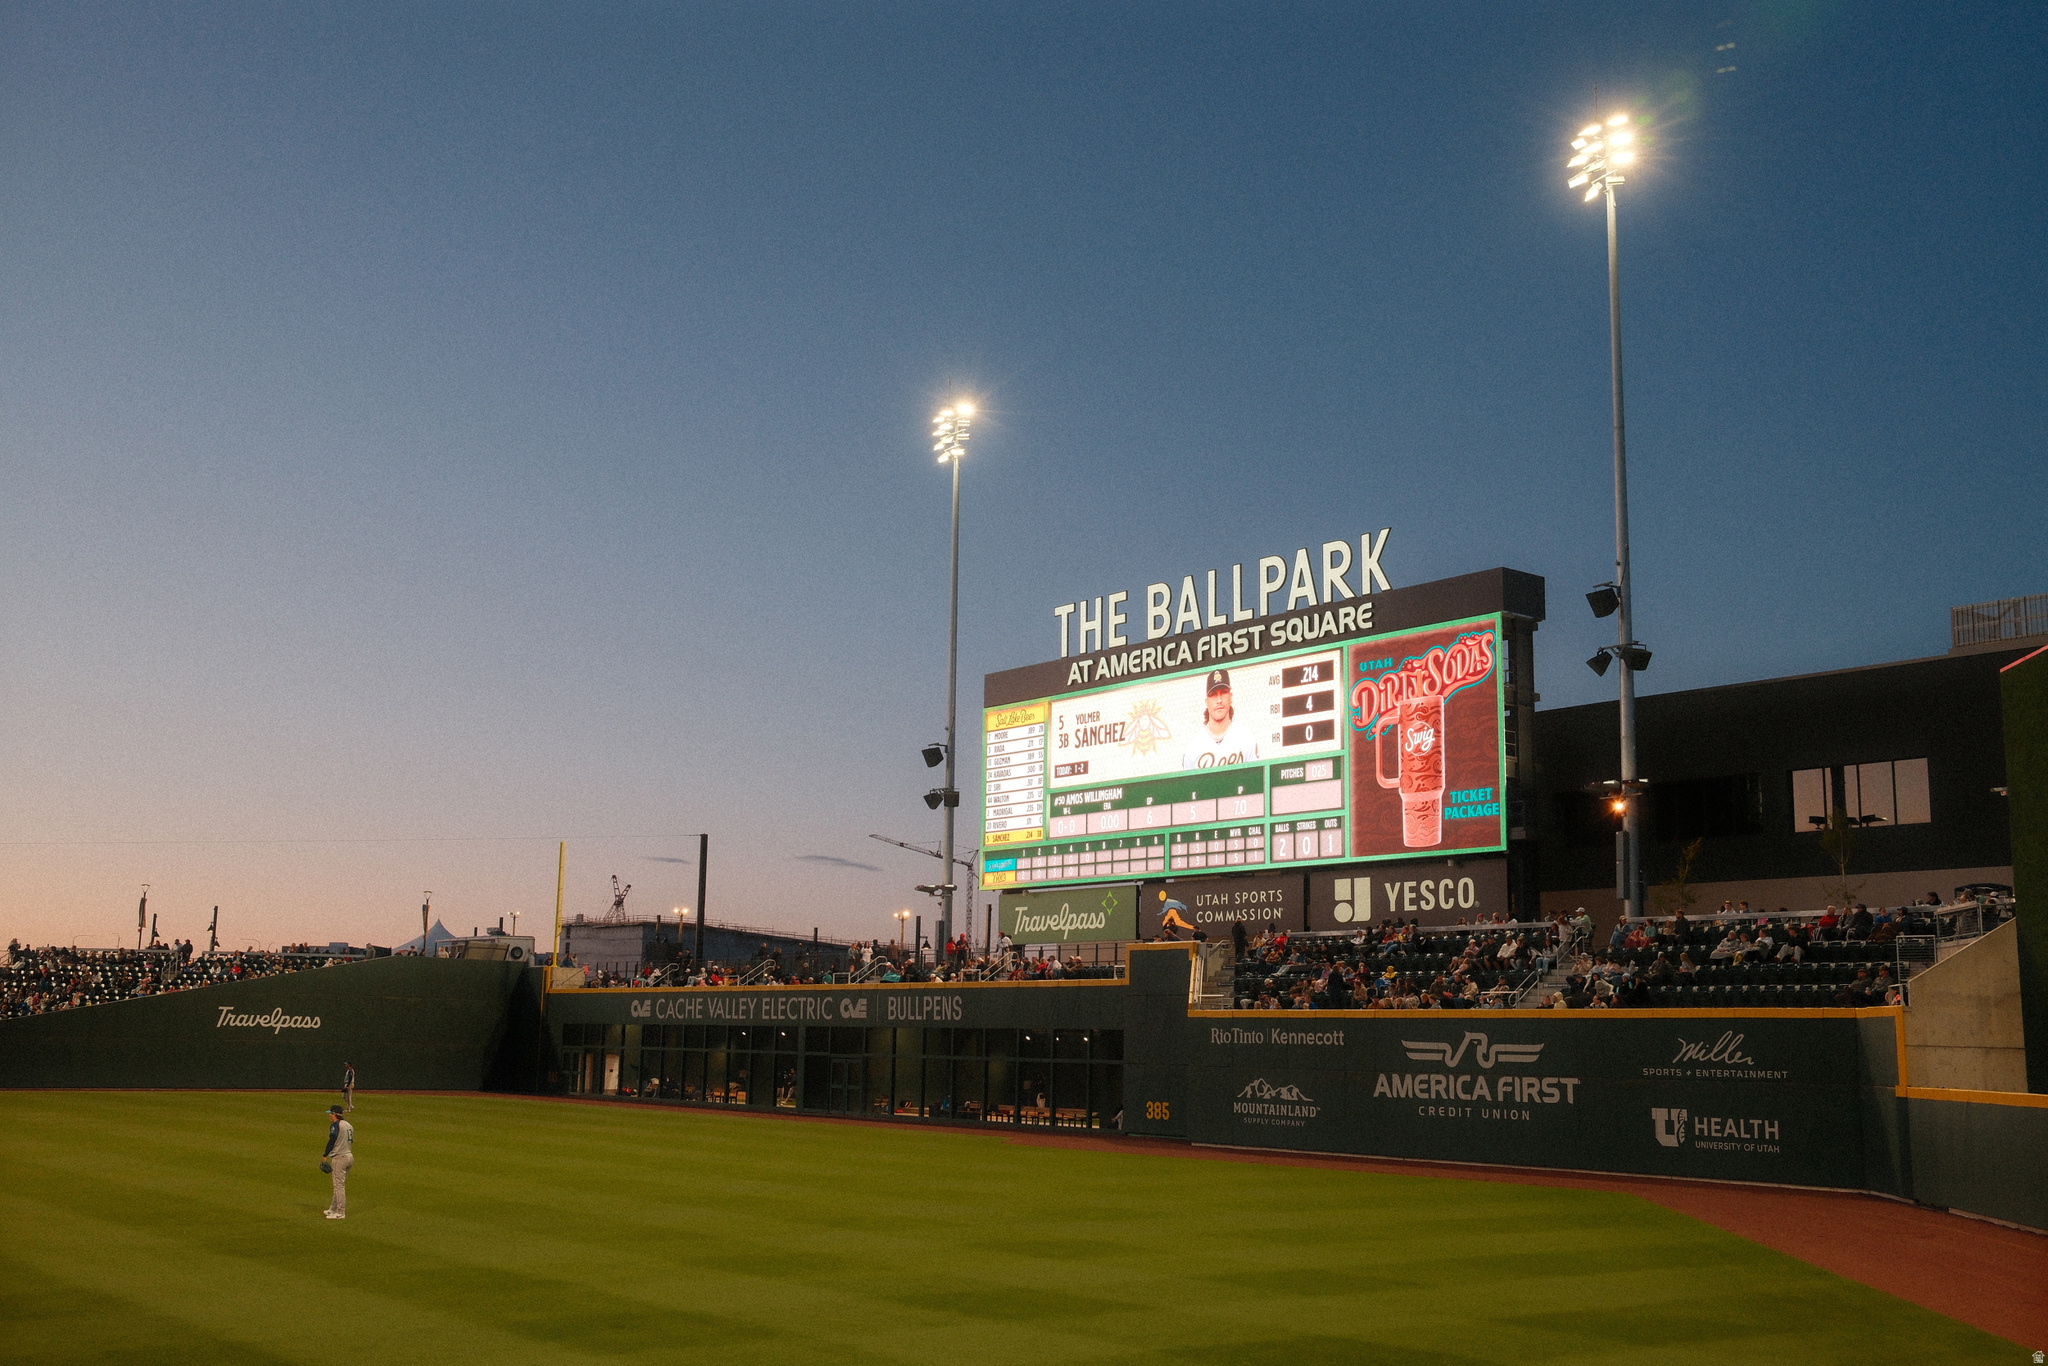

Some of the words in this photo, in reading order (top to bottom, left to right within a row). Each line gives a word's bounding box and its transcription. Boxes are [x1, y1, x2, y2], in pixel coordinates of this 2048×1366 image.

[1054, 590, 1128, 658] THE
[1147, 527, 1392, 640] BALLPARK
[1067, 659, 1094, 686] AT
[1095, 641, 1193, 681] AMERICA
[1197, 625, 1266, 661] FIRST
[1270, 602, 1374, 647] SQUARE
[1359, 657, 1393, 672] UTAH
[1423, 632, 1494, 697] SODAS
[1268, 675, 1281, 686] AVG
[1300, 664, 1319, 684] .214
[1270, 703, 1281, 714] RBI
[1305, 695, 1313, 712] 4
[996, 713, 1007, 728] Salt
[1006, 711, 1020, 726] Lake
[1058, 715, 1065, 730] 5
[1075, 710, 1101, 724] YOLMER
[1058, 733, 1069, 749] 3B
[1074, 721, 1126, 749] SÁNCHEZ
[1271, 732, 1281, 743] HR
[1305, 724, 1313, 742] 0
[1405, 726, 1436, 752] Swig
[1056, 765, 1072, 776] TODAY:
[1074, 763, 1085, 773] 1-2
[1280, 767, 1304, 779] PITCHES
[1311, 765, 1327, 778] 025
[1054, 796, 1066, 806] #50
[1066, 792, 1083, 805] AMOS
[1083, 788, 1123, 803] WILLINGHAM
[1450, 787, 1493, 803] TICKET
[1100, 814, 1120, 830] 0.00
[1146, 810, 1153, 825] 6
[1190, 805, 1196, 821] 5
[1234, 800, 1247, 816] 7.0
[1103, 802, 1111, 810] ERA
[1444, 802, 1500, 820] PACKAGE
[1229, 828, 1241, 837] MVR
[1248, 826, 1262, 835] CHAL
[1275, 823, 1290, 833] BALLS
[1296, 821, 1317, 831] STRIKES
[1324, 818, 1338, 828] OUTS
[1279, 838, 1286, 857] 2
[1302, 836, 1311, 856] 0
[1328, 834, 1333, 853] 1
[1196, 893, 1229, 907] UTAH
[1234, 889, 1283, 905] SPORTS
[1384, 876, 1476, 912] YESCO
[1014, 902, 1106, 940] Travelpass
[1196, 907, 1282, 924] COMMISSION
[655, 998, 703, 1019] CACHE
[707, 998, 758, 1020] VALLEY
[762, 997, 833, 1020] ELECTRIC
[888, 995, 963, 1021] BULLPENS
[216, 1006, 322, 1035] Travelpass
[1271, 1028, 1345, 1046] Kennecott
[1672, 1030, 1755, 1066] Miller
[1642, 1068, 1682, 1077] SPORTS
[1695, 1068, 1788, 1079] ENTERTAINMENT
[1373, 1073, 1492, 1102] AMERICA
[1497, 1076, 1581, 1105] FIRST
[1146, 1101, 1170, 1120] 385
[1233, 1101, 1317, 1118] MOUNTAINLAND
[1418, 1105, 1473, 1118] CREDIT
[1481, 1108, 1531, 1121] UNION
[1243, 1117, 1269, 1125] SUPPLY
[1271, 1118, 1306, 1127] COMPANY
[1694, 1116, 1780, 1141] HEALTH
[1695, 1140, 1742, 1152] UNIVERSITY
[1743, 1142, 1756, 1152] OF
[1757, 1143, 1781, 1154] UTAH
